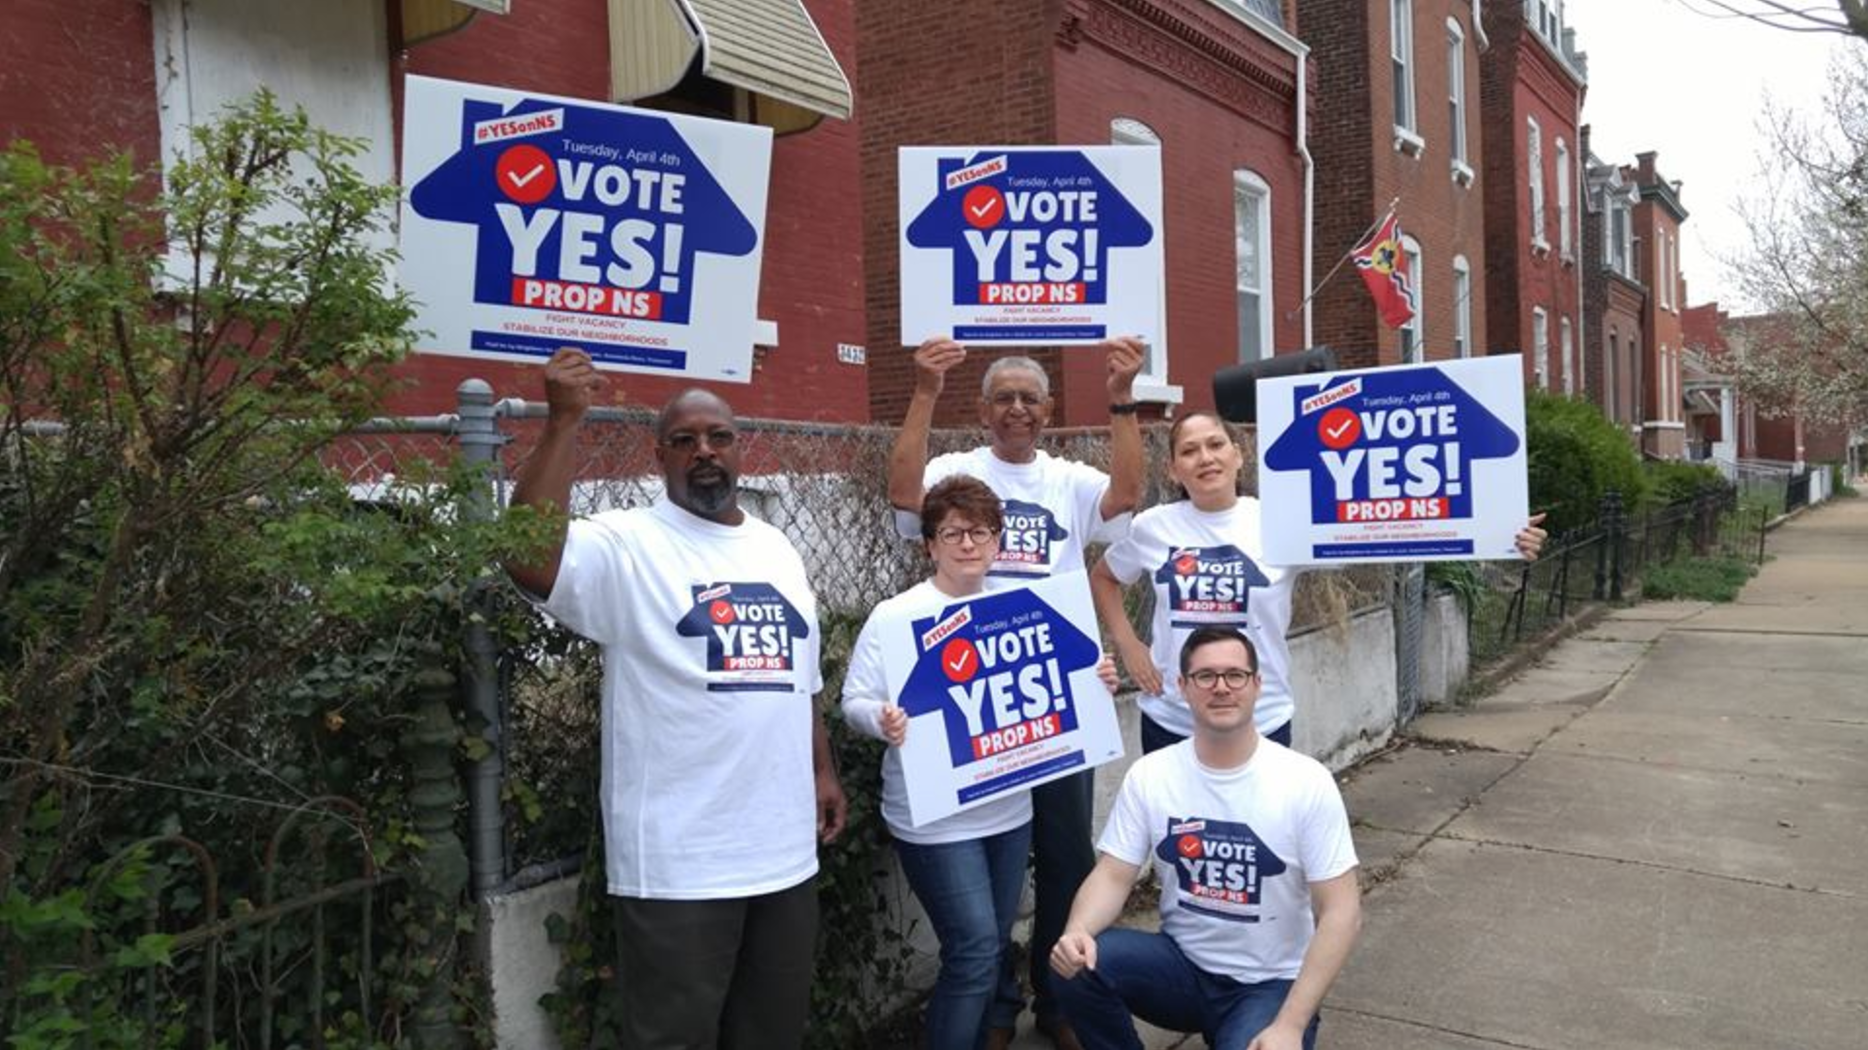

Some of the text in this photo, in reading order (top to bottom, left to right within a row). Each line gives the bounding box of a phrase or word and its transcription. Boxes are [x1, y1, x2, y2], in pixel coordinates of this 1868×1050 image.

[478, 115, 556, 139] #YESonNS
[562, 139, 681, 166] Tuesday, April 4th
[557, 158, 686, 214] VOTE
[949, 161, 1003, 186] #YESonNS
[1007, 177, 1092, 188] Tuesday, April 4th
[1005, 191, 1098, 222] VOTE
[494, 202, 684, 293] YES!
[962, 228, 1098, 282] YES!
[524, 279, 650, 316] PROP NS
[987, 283, 1078, 303] PROP NS
[503, 322, 669, 346] STABILIZE OUR NEIGHBORHOODS
[546, 314, 628, 329] FIGHT VACANCY
[1303, 383, 1358, 411] #YESonNS
[1363, 391, 1451, 407] Tuesday, April 4th
[1360, 405, 1457, 440] VOTE
[1319, 442, 1462, 500] YES!
[1004, 515, 1047, 529] VOTE
[1346, 499, 1441, 520] PROP NS
[1002, 528, 1047, 554] ES!
[1197, 561, 1244, 575] VOTE
[1174, 575, 1245, 602] YES!
[732, 604, 785, 622] VOTE
[1185, 602, 1217, 610] PROP
[713, 624, 790, 657] YES!
[976, 623, 1055, 669] VOTE
[729, 657, 782, 669] PROP NS
[948, 657, 1067, 737] YES!
[979, 716, 1055, 756] PROP NS
[1203, 840, 1256, 862] VOTE
[1180, 856, 1257, 893] YES!
